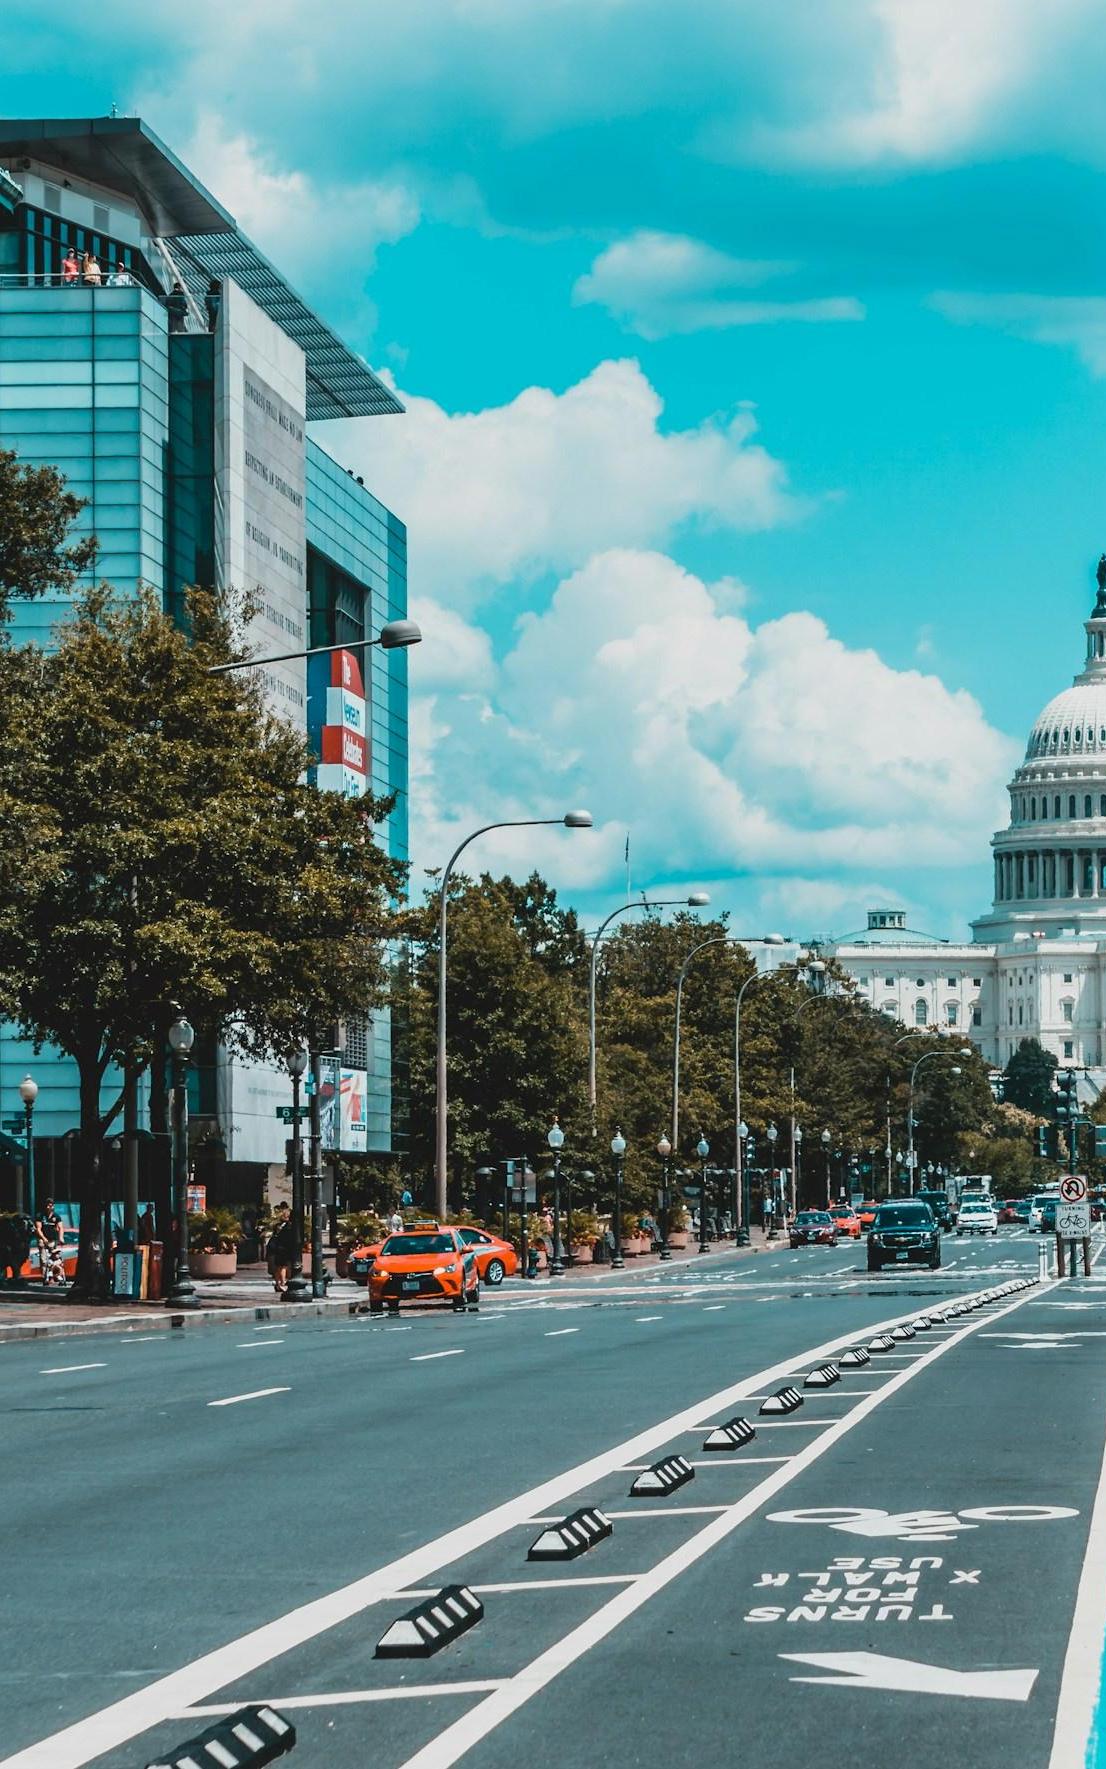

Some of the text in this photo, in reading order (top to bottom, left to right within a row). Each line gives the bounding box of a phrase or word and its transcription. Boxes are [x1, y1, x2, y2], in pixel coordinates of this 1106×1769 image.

[282, 1107, 290, 1117] 6
[827, 1556, 943, 1570] USE
[753, 1569, 982, 1587] X WALK
[802, 1587, 919, 1603] FOR
[743, 1604, 954, 1622] TURNS
